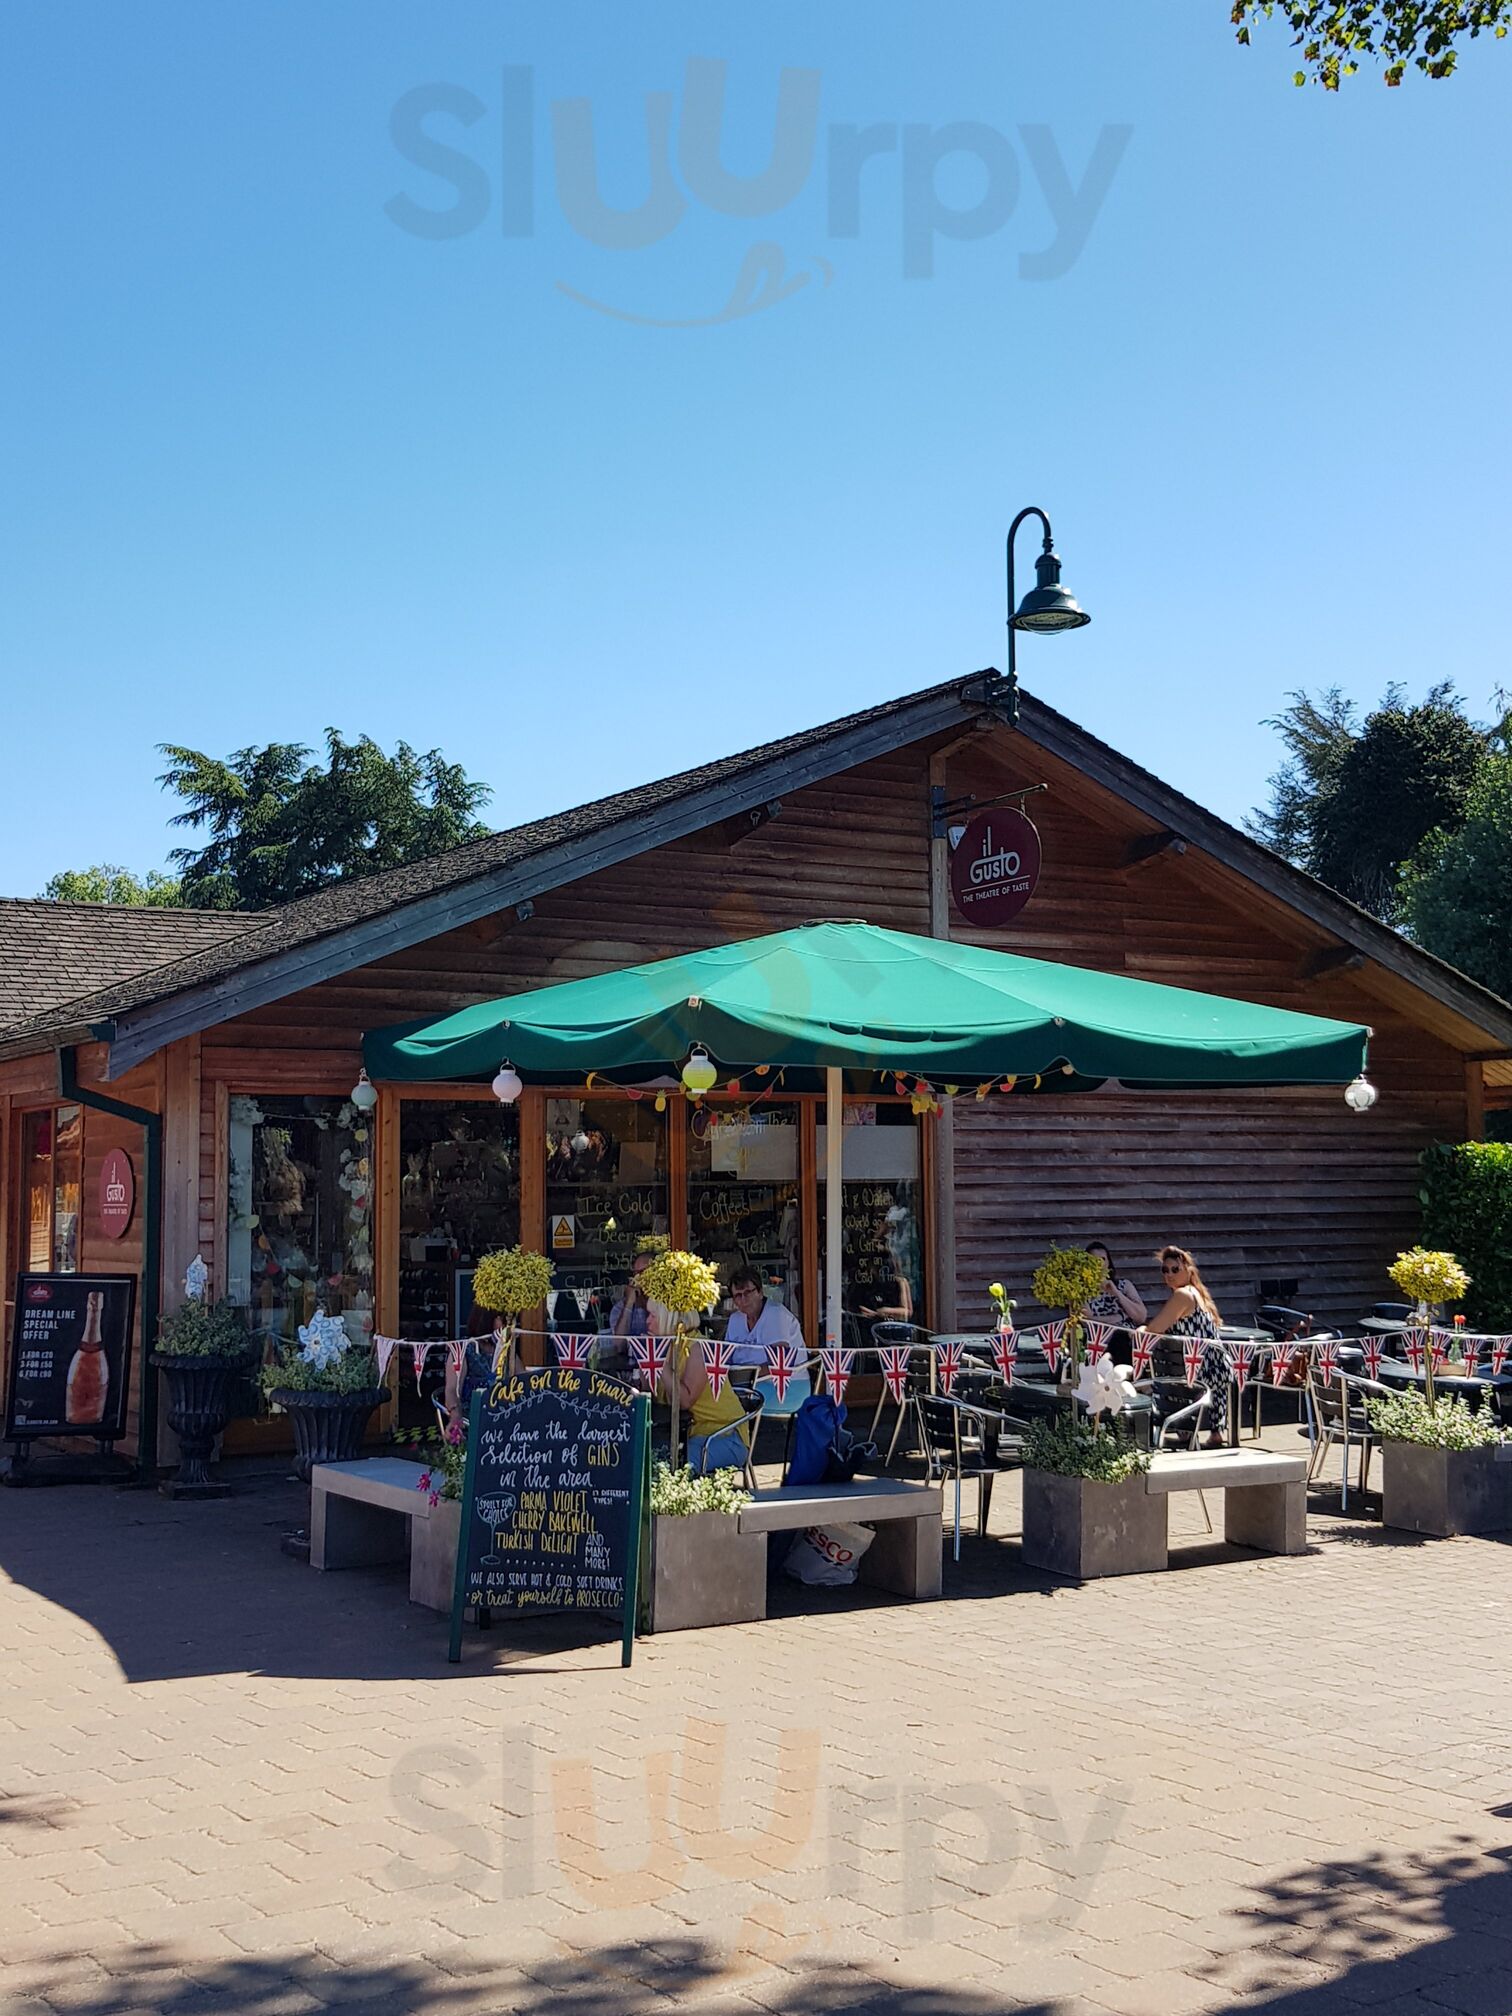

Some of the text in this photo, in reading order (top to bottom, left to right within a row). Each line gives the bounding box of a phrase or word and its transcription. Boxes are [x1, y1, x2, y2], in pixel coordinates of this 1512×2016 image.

[963, 882, 1030, 903] THE THEATRE OF TASTE
[618, 1191, 653, 1214] Cold
[699, 1192, 750, 1224] Coffees
[24, 1309, 76, 1319] DREAM LINE
[23, 1320, 59, 1329] SPECIAL
[22, 1331, 50, 1340] OFFER
[27, 1351, 40, 1359] FOR
[24, 1370, 39, 1378] FOR
[489, 1369, 634, 1407] Cafe on the Square
[509, 1422, 539, 1441] have
[545, 1420, 568, 1440] the
[577, 1420, 631, 1448] largest
[561, 1443, 579, 1467] of
[587, 1442, 620, 1467] GINS
[500, 1469, 516, 1487] in
[523, 1465, 550, 1488] the
[520, 1490, 588, 1513] PARMA VIOLET
[601, 1489, 629, 1497] DIFFERENT
[501, 1497, 513, 1508] FOR
[483, 1508, 509, 1523] CHOICE
[512, 1510, 599, 1534] CHERRY BAKEWELL
[495, 1530, 533, 1550] TURKISH
[585, 1534, 605, 1546] AND
[585, 1546, 611, 1558] MANY
[584, 1558, 611, 1571] MORE!
[470, 1572, 483, 1584] WE
[487, 1572, 505, 1585] ALSO
[508, 1572, 527, 1586] SERVE
[530, 1573, 543, 1586] HOT
[545, 1573, 552, 1587] &
[555, 1574, 573, 1588] COLD
[576, 1575, 593, 1589] SOFT
[471, 1590, 483, 1605] or
[486, 1588, 514, 1606] treat
[518, 1586, 563, 1608] yourself
[564, 1588, 574, 1605] to
